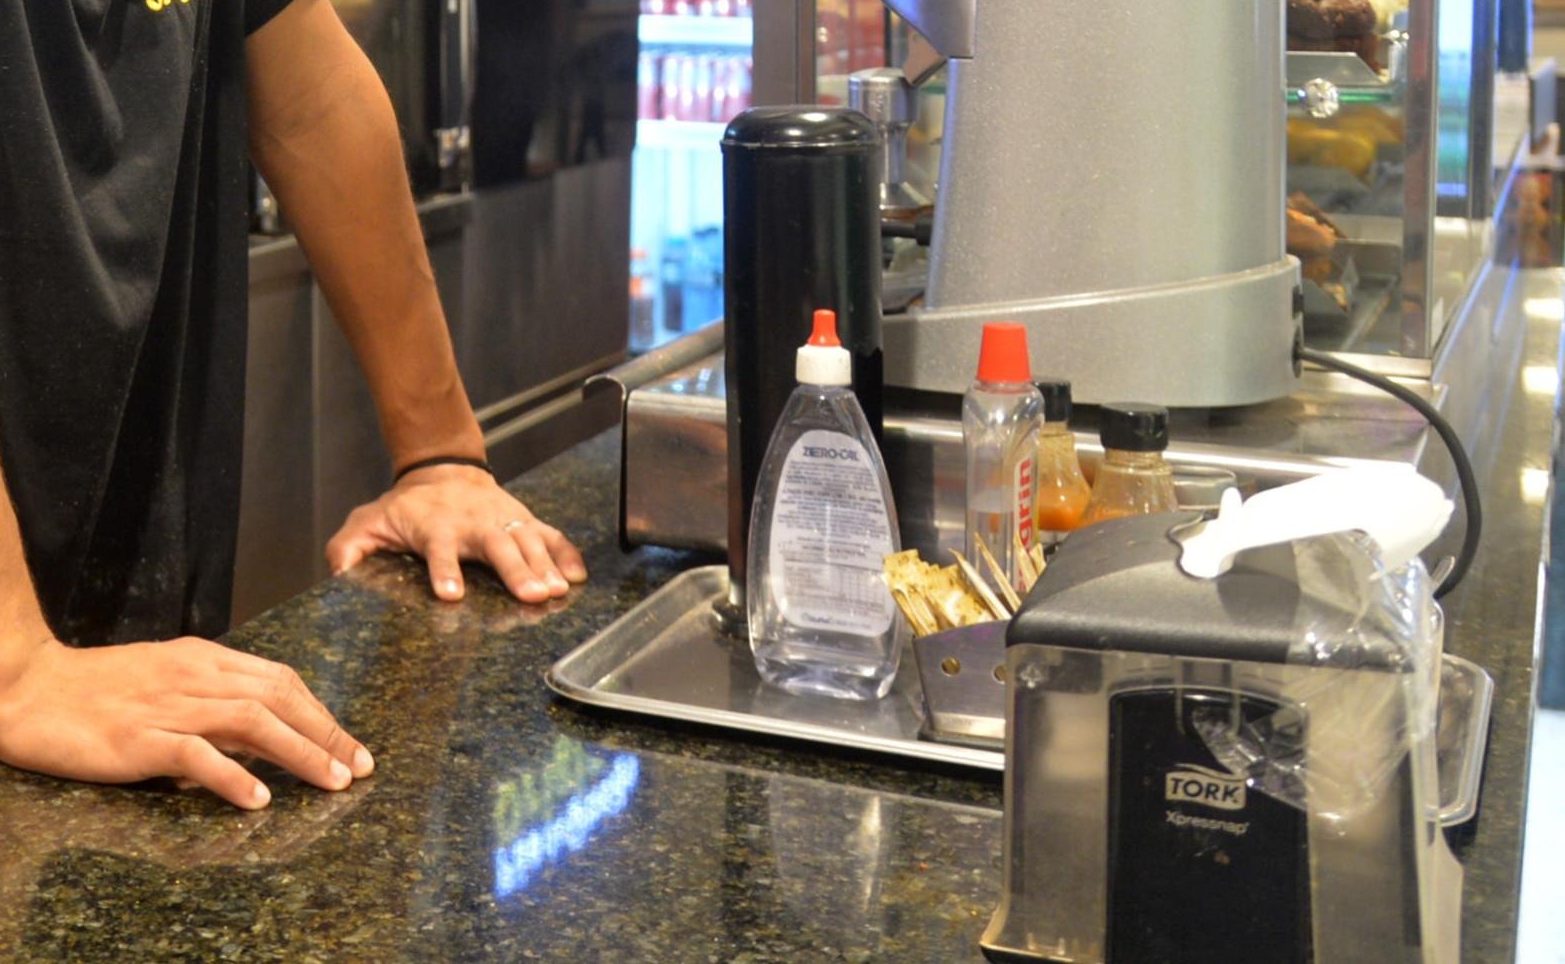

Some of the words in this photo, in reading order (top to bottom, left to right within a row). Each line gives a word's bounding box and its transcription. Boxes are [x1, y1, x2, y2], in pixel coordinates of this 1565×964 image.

[1018, 458, 1034, 560] grin
[1169, 777, 1239, 805] TORK
[1164, 810, 1248, 836] Xpressnap
